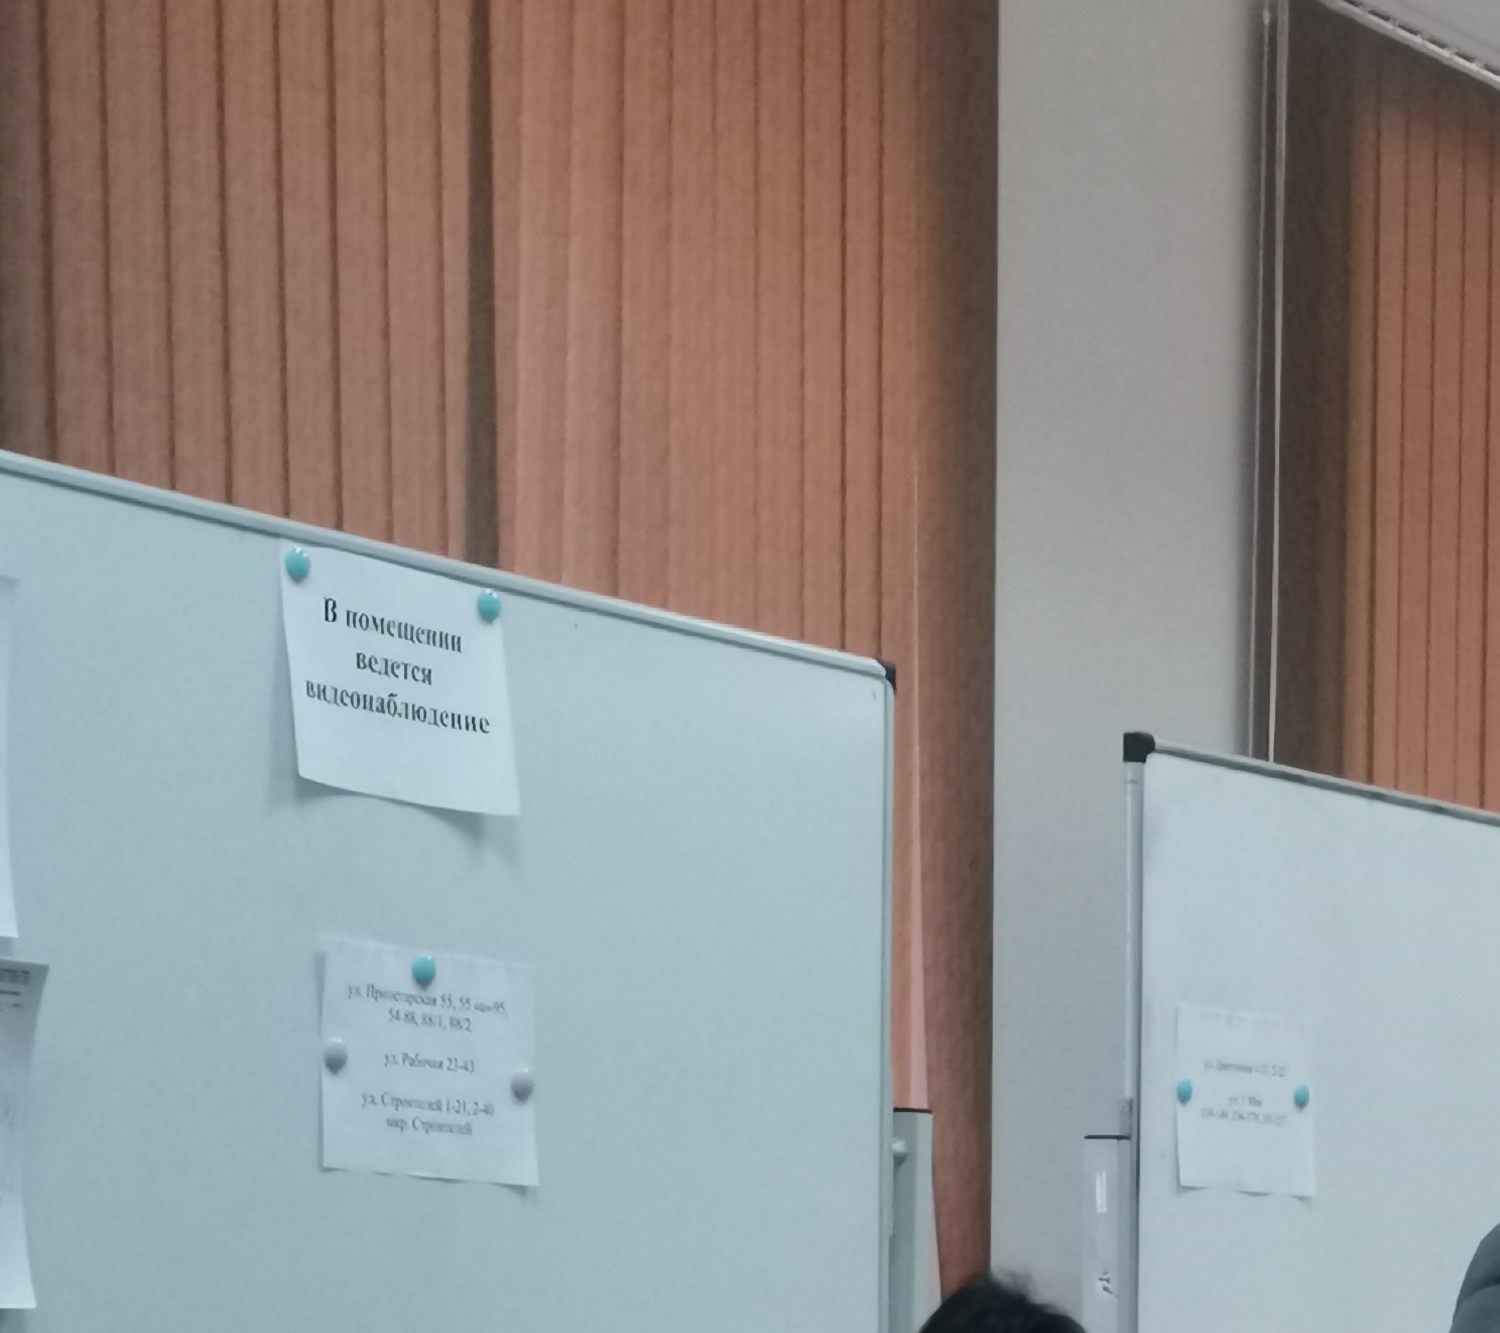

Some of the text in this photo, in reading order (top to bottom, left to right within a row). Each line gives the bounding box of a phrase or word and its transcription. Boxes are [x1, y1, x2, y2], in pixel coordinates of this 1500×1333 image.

[323, 597, 463, 654] В помещении
[355, 651, 433, 686] ведется
[305, 679, 491, 734] видеонаблюдение
